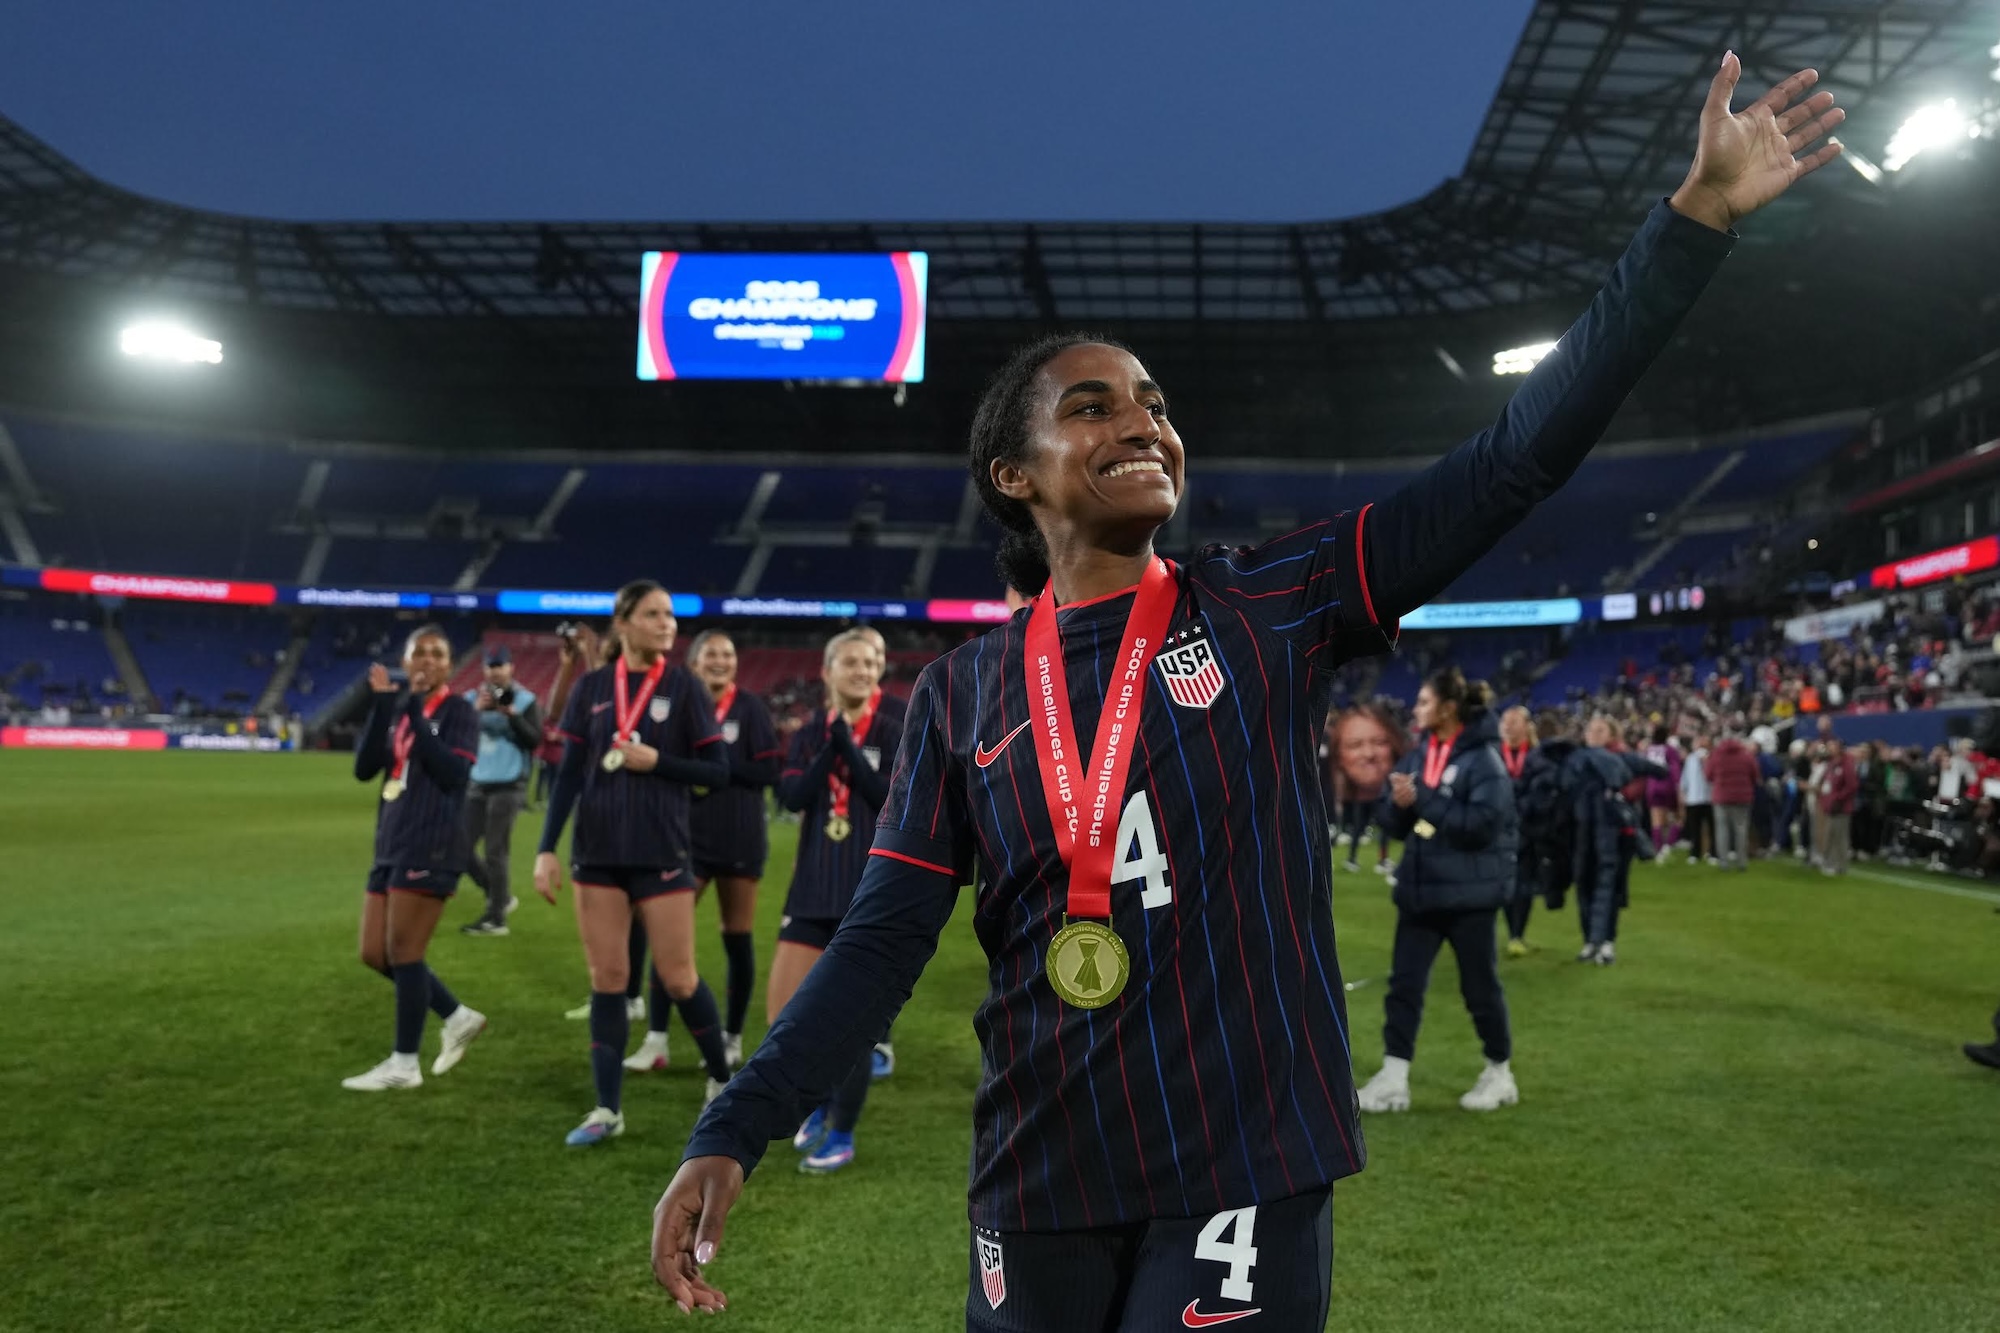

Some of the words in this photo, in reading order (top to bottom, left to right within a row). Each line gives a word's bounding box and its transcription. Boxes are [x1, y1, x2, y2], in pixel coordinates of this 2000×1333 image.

[1161, 643, 1209, 675] USA
[1038, 655, 1064, 761] shebelieves
[1056, 764, 1072, 803] cup
[1089, 723, 1122, 847] shebelieves
[1116, 684, 1133, 719] cup
[1125, 637, 1147, 681] 2026
[1110, 789, 1173, 909] 4
[1053, 926, 1109, 950] shebelieves
[1194, 1205, 1259, 1302] 4
